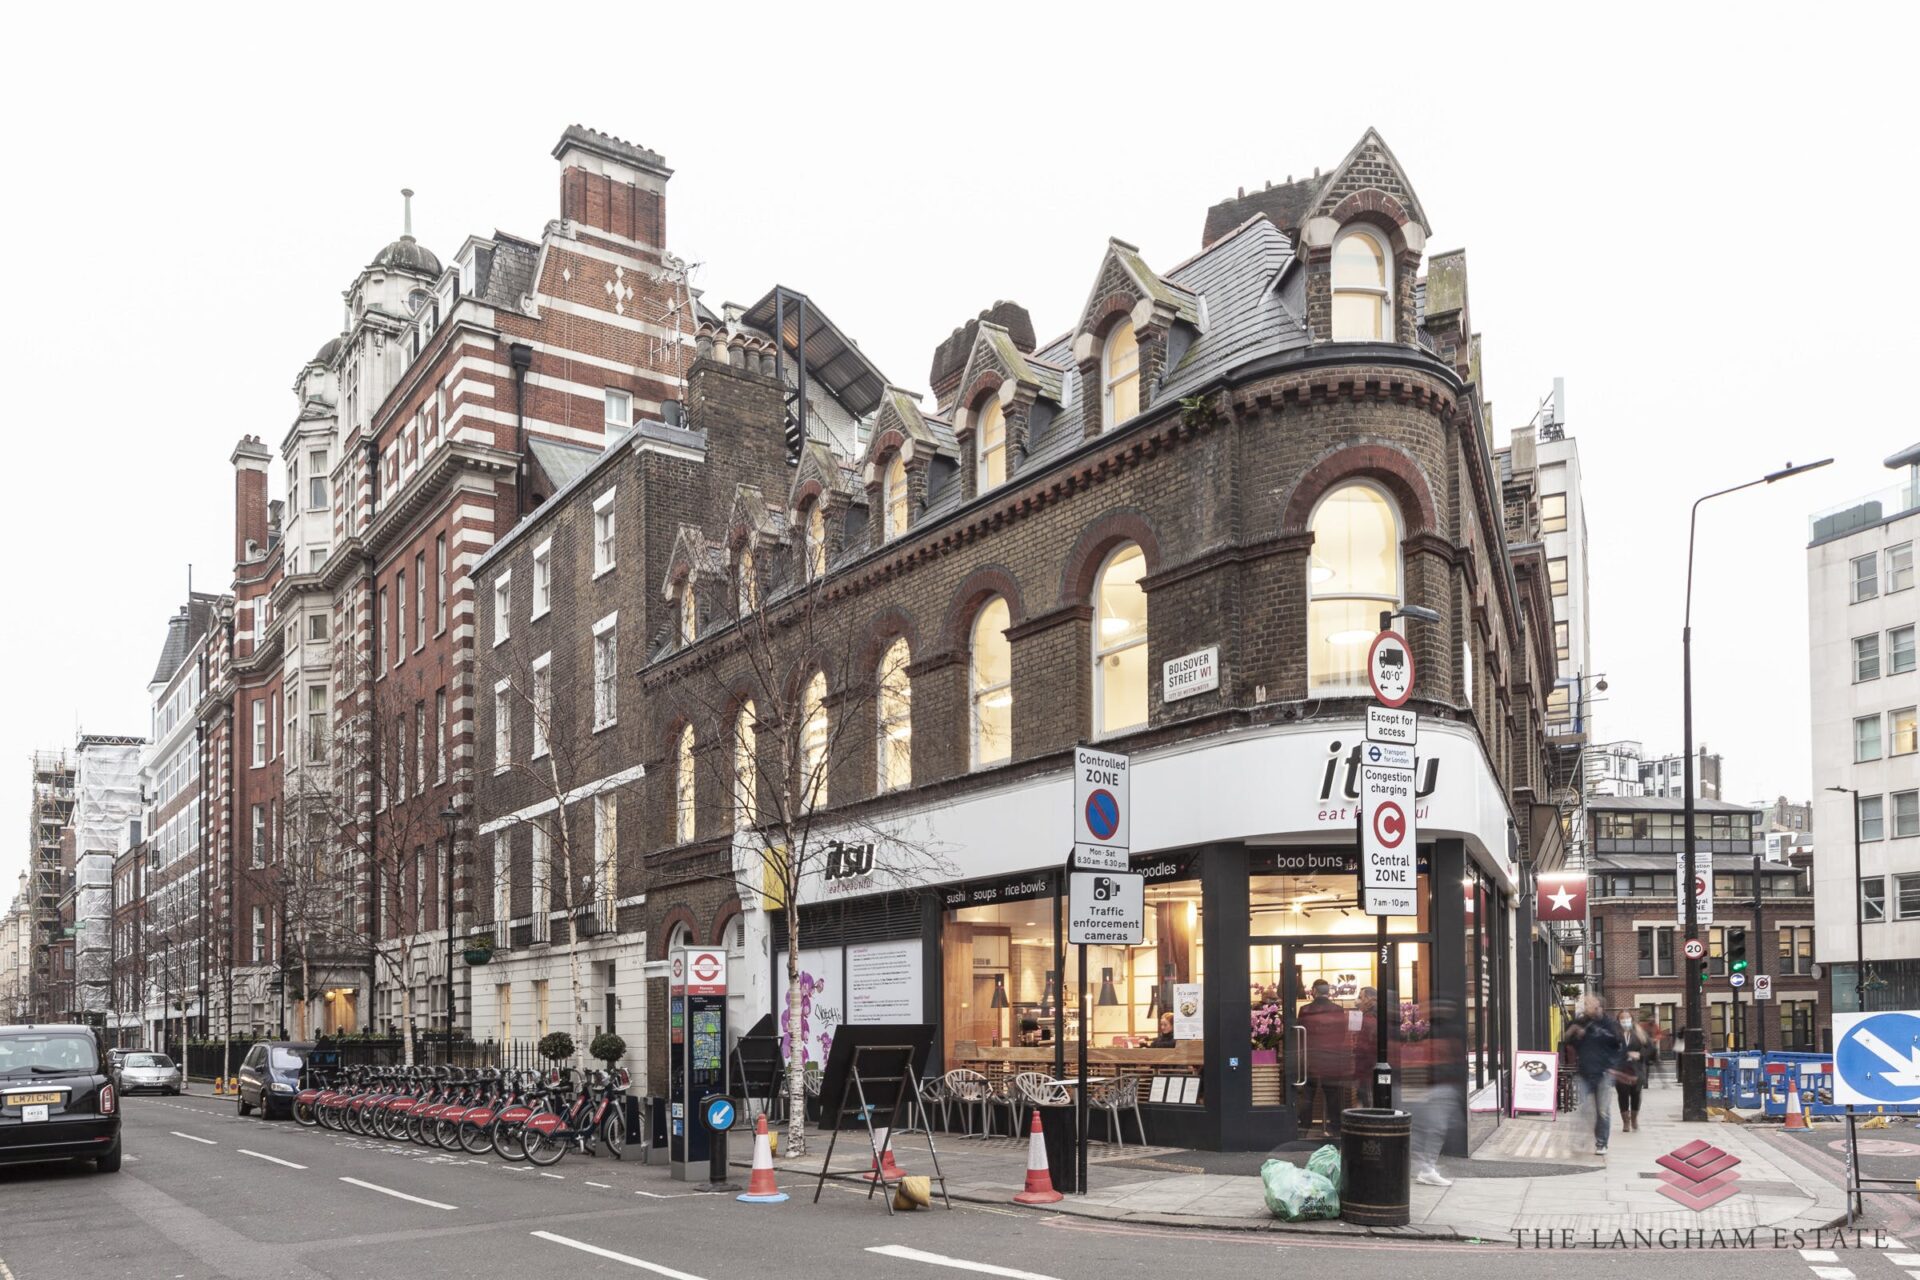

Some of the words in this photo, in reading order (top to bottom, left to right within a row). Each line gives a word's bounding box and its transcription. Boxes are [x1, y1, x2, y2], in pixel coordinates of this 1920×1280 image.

[1169, 653, 1209, 675] BOLSOVER
[1169, 670, 1198, 688] STREET
[1200, 666, 1211, 678] W1
[1371, 711, 1399, 725] Except
[1401, 715, 1413, 726] for
[1378, 727, 1406, 738] access
[1384, 748, 1407, 757] Transport
[1079, 752, 1126, 771] Controlled
[1392, 757, 1410, 765] London
[1320, 740, 1440, 800] itu
[1365, 769, 1412, 783] Congestion
[1086, 769, 1119, 786] ZONE
[1370, 784, 1407, 797] charging
[1318, 807, 1346, 821] eat
[1089, 847, 1102, 856] Mon
[1105, 849, 1116, 857] Sat
[1077, 856, 1091, 865] 8.30
[1104, 859, 1117, 867] 6.30
[1277, 853, 1304, 868] bao
[1308, 853, 1343, 868] buns
[1371, 853, 1410, 867] Central
[1375, 869, 1406, 882] ZONE
[946, 891, 966, 904] sushi
[973, 888, 997, 902] soups
[1005, 884, 1020, 896] rice
[1021, 880, 1046, 894] bowls
[1089, 906, 1124, 917] Traffic
[1073, 918, 1140, 930] enforcement
[1084, 930, 1128, 941] cameras
[1686, 945, 1702, 953] 20
